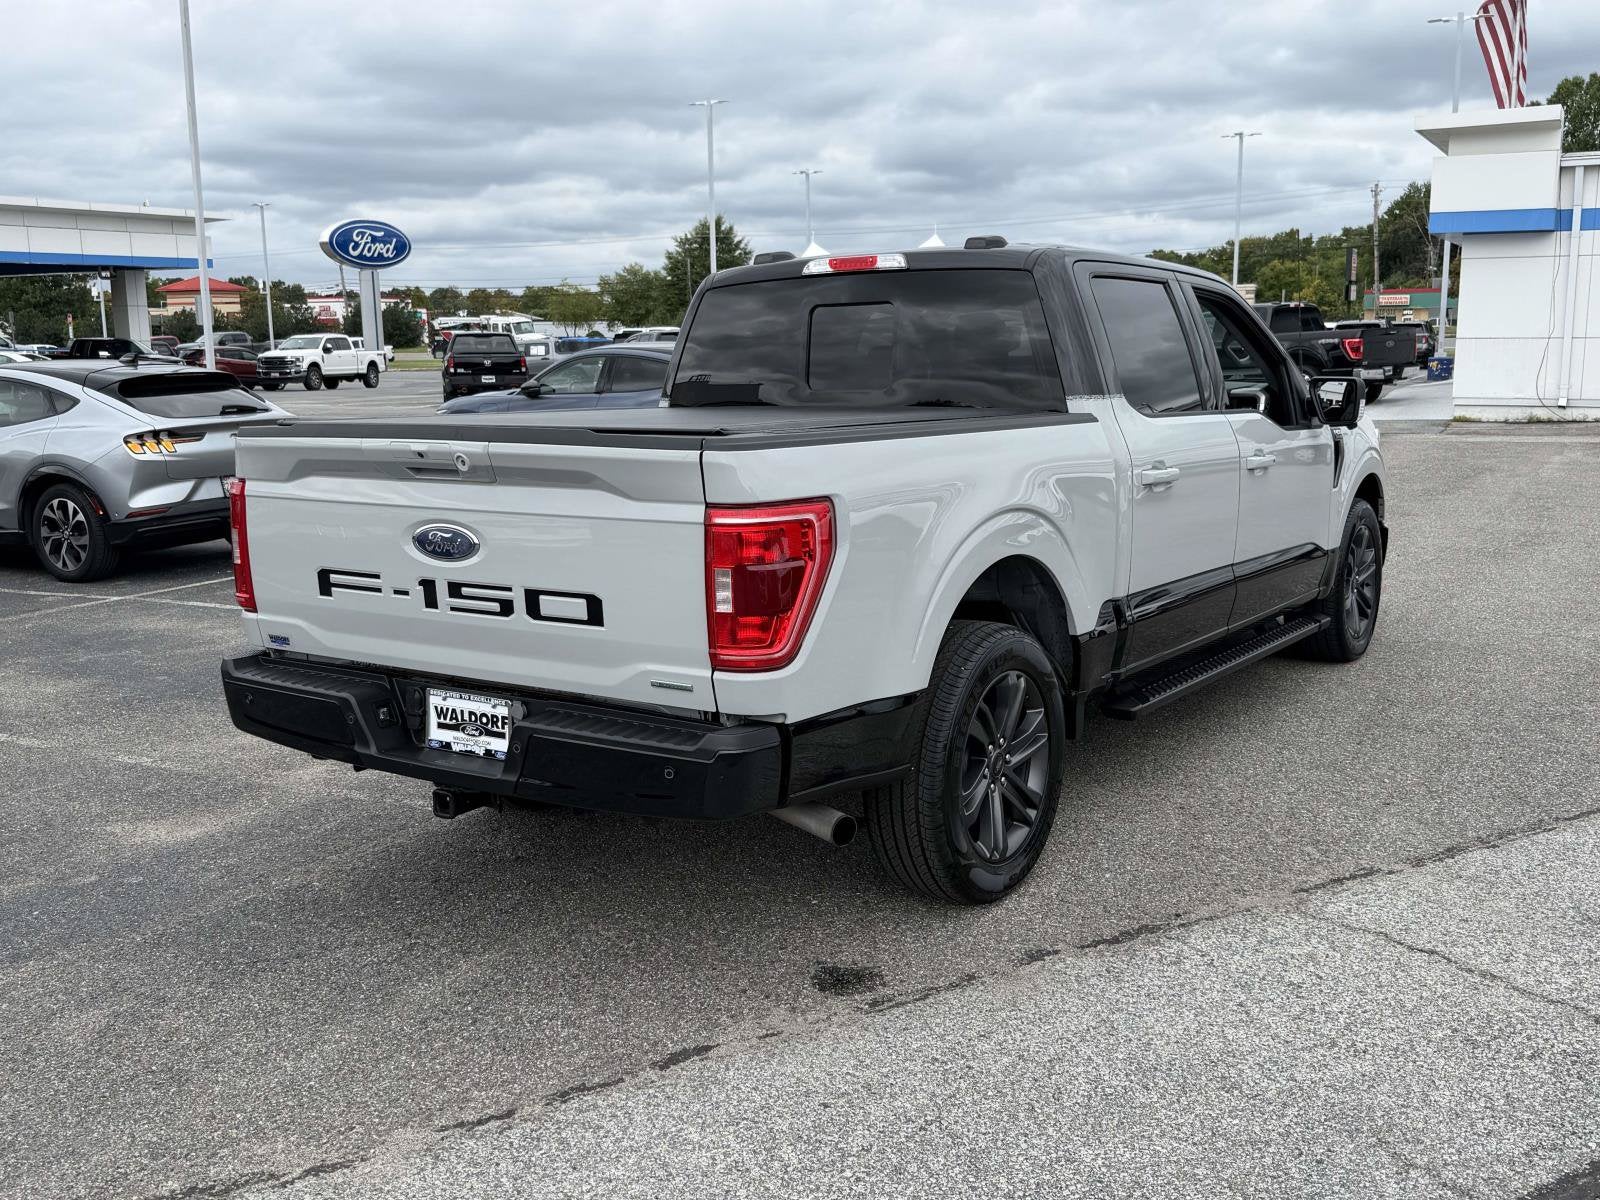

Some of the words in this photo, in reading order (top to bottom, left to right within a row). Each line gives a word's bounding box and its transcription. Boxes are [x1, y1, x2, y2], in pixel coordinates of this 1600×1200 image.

[349, 228, 397, 258] Ford
[425, 530, 462, 554] Ford
[317, 567, 605, 628] F-150
[430, 689, 460, 698] DEDICATED
[470, 695, 506, 705] EXCELLENCE
[434, 704, 509, 730] WALDORF
[464, 725, 480, 736] Ford
